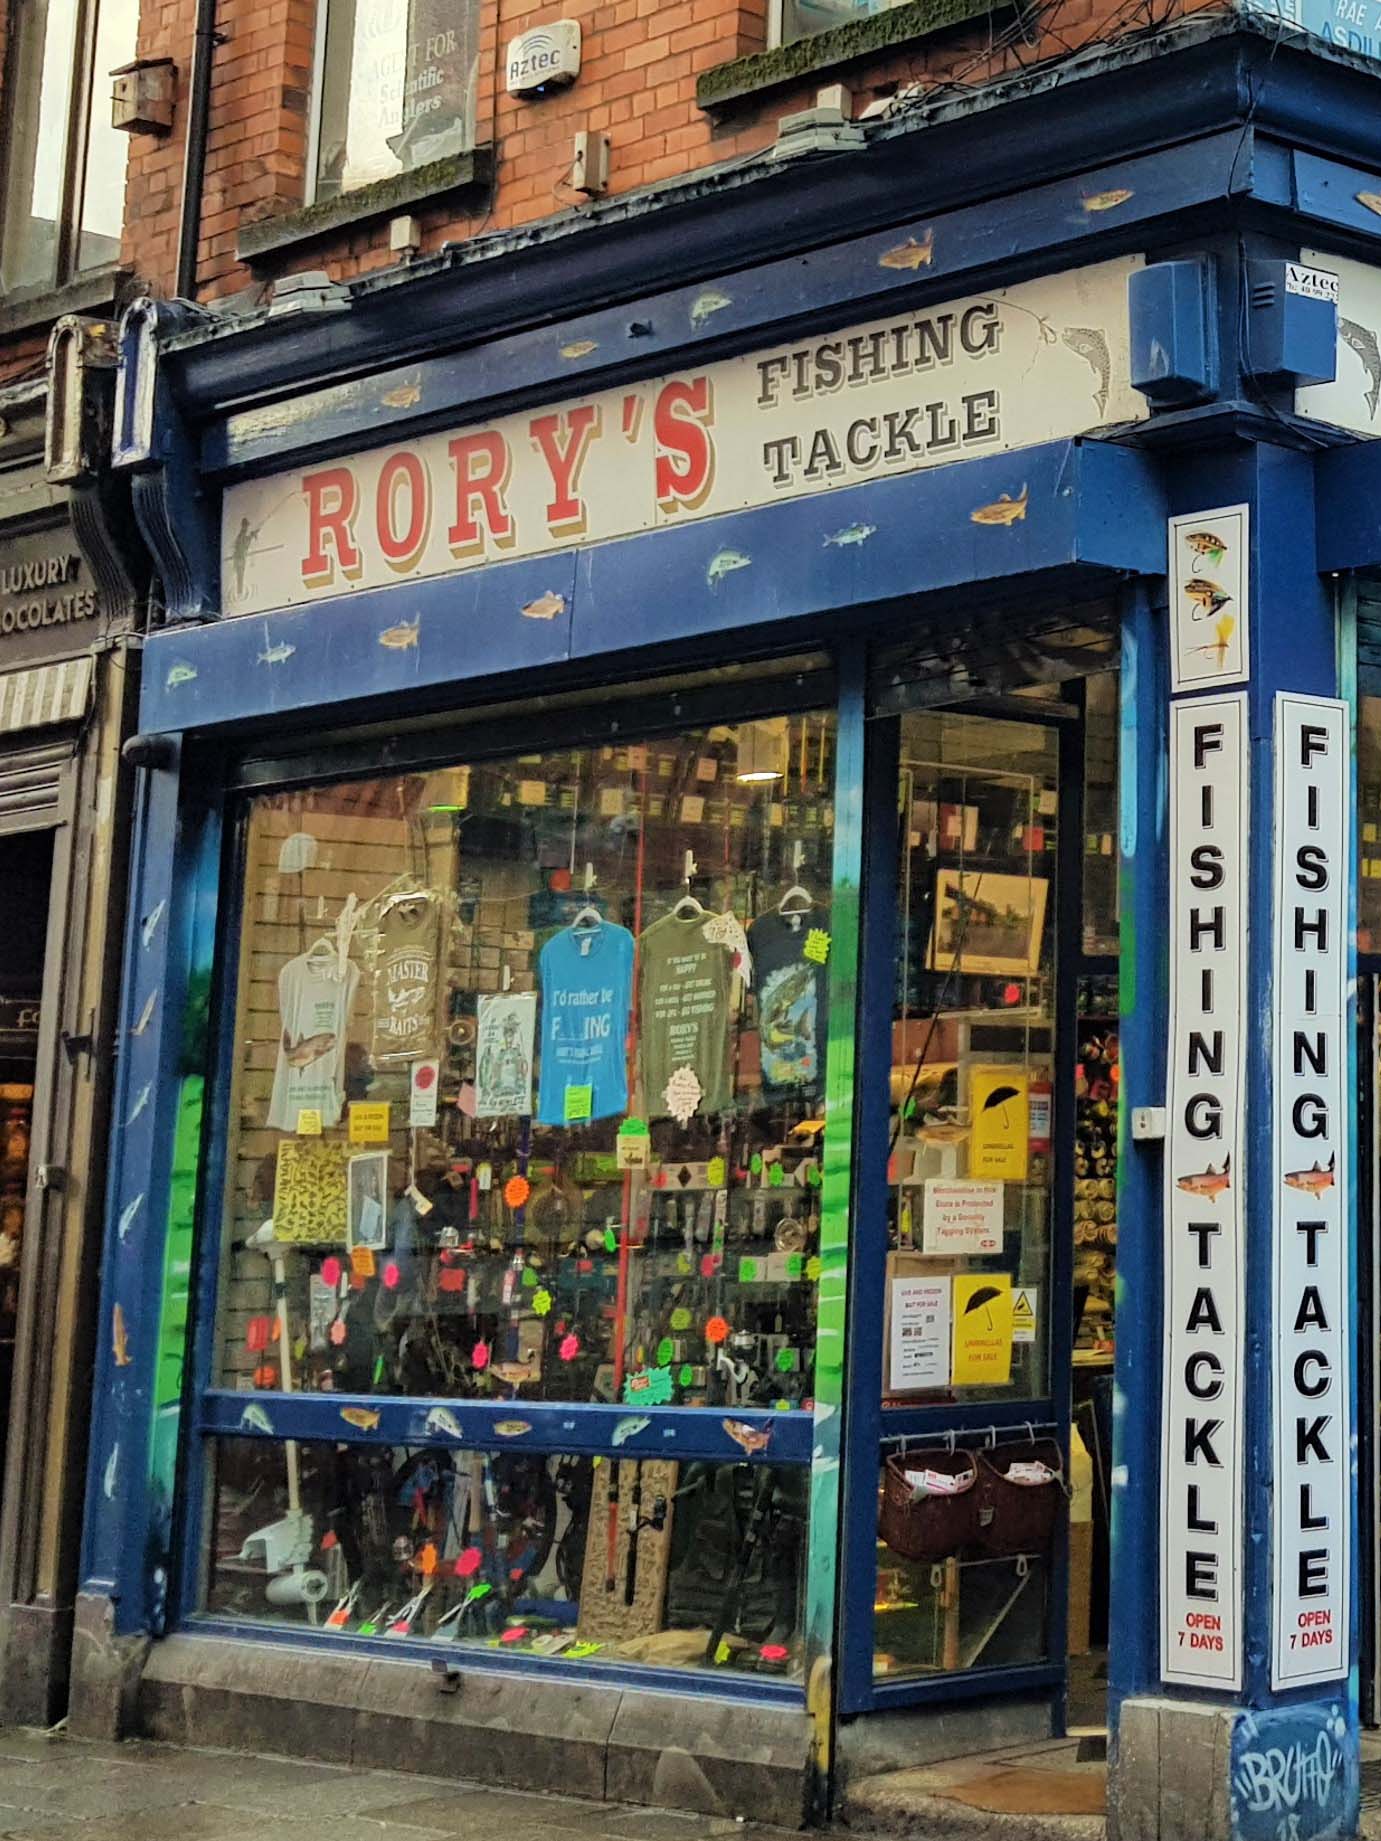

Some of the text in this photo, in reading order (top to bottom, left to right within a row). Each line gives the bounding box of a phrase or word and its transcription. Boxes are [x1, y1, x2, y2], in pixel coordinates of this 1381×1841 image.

[1336, 0, 1367, 26] RAE
[425, 29, 457, 62] FOR
[510, 49, 561, 81] Aztec
[1286, 267, 1339, 292] Aztec
[757, 303, 1003, 409] FISHING
[764, 389, 1001, 488] TACKLE
[301, 374, 715, 590] RORY'S
[1, 554, 71, 595] LUXURY
[1183, 722, 1227, 1603] FISHING TACKLE
[1291, 723, 1334, 1599] FISHING TACKLE
[1186, 1612, 1221, 1631] OPEN
[1298, 1609, 1331, 1628] OPEN
[1178, 1631, 1223, 1651] 7 DAYS
[1290, 1629, 1333, 1649] 7 DAYS
